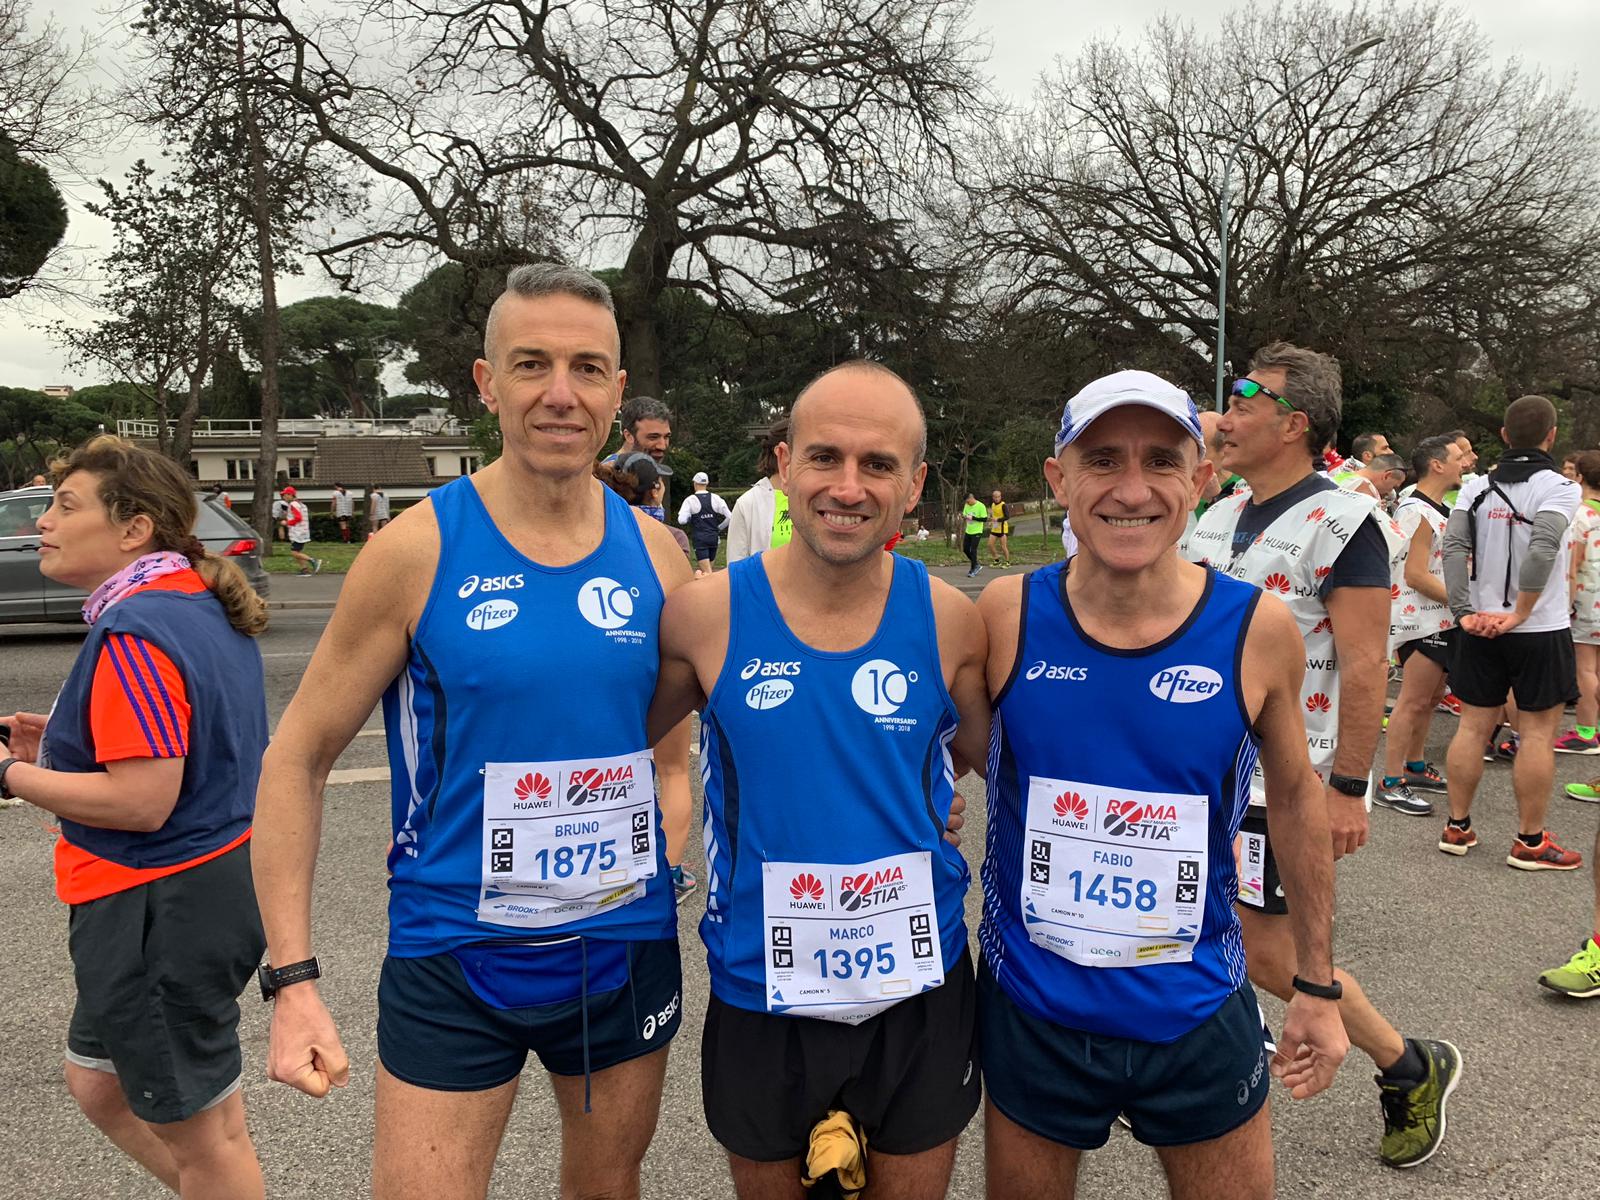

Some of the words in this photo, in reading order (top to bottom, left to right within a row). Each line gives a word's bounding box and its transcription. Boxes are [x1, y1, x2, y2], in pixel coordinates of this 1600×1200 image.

[471, 604, 517, 630] Pfizer
[605, 630, 646, 638] ANNIVERSARIO
[1156, 670, 1220, 702] Pfizer
[751, 684, 792, 710] Pfizer
[874, 716, 918, 726] ANNIVERSARIO
[568, 765, 634, 790] ROMA
[514, 800, 552, 810] HUAWEI
[1106, 799, 1177, 824] ROMA
[555, 821, 599, 838] BRUNO
[1052, 818, 1088, 830] HUAWEI
[535, 839, 617, 881] 1875
[1093, 850, 1133, 868] FABIO
[841, 866, 904, 895] ROMA
[1068, 870, 1158, 912] 1458
[507, 904, 540, 914] BROOKS
[790, 902, 826, 910] HUAWEI
[1051, 908, 1071, 917] CAMION
[830, 924, 874, 940] MARCO
[1046, 934, 1075, 947] BROOKS
[1090, 946, 1122, 958] acea
[814, 942, 896, 980] 1395
